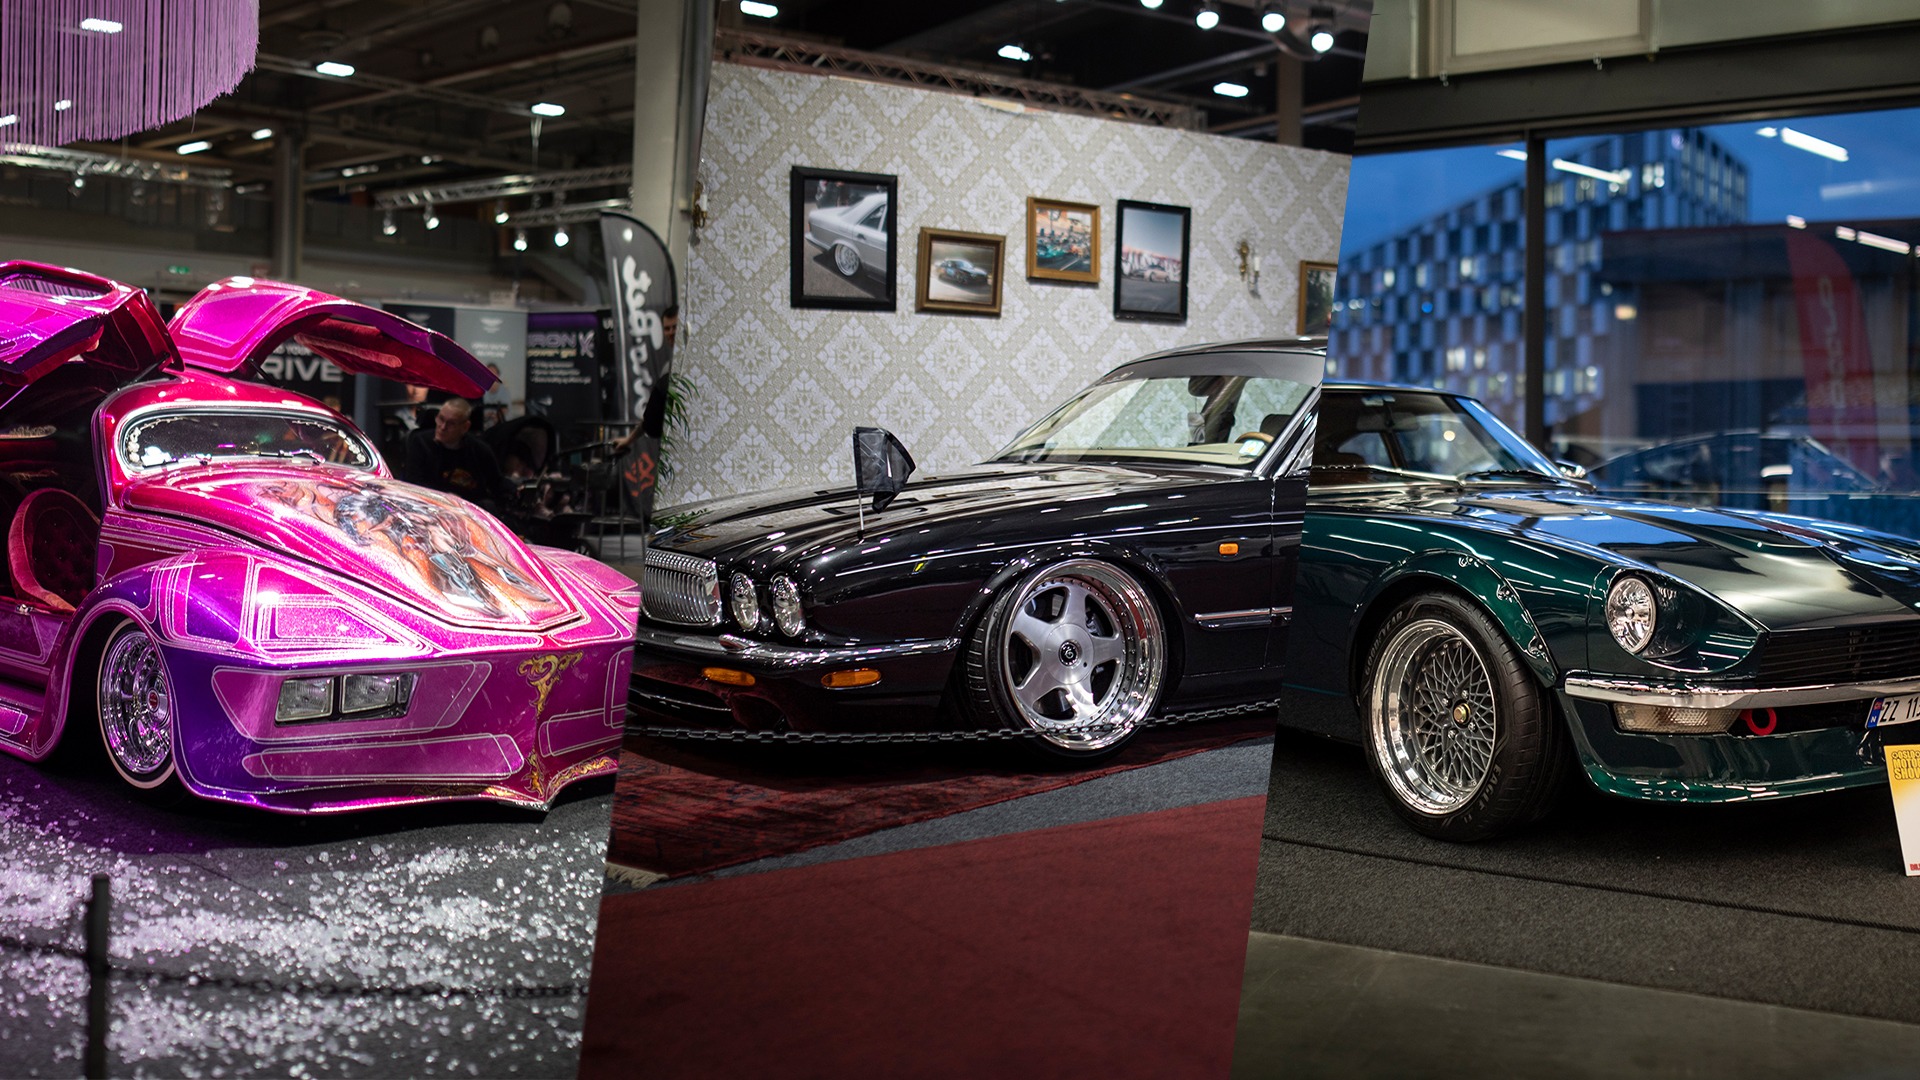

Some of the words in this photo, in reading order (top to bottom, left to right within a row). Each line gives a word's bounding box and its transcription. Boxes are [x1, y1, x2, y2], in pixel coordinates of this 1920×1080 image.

[257, 356, 344, 382] RIVE
[1365, 610, 1403, 676] GOODYEAR
[1870, 715, 1877, 723] N
[1880, 699, 1900, 722] ZZ
[1478, 764, 1502, 811] EAGLE
